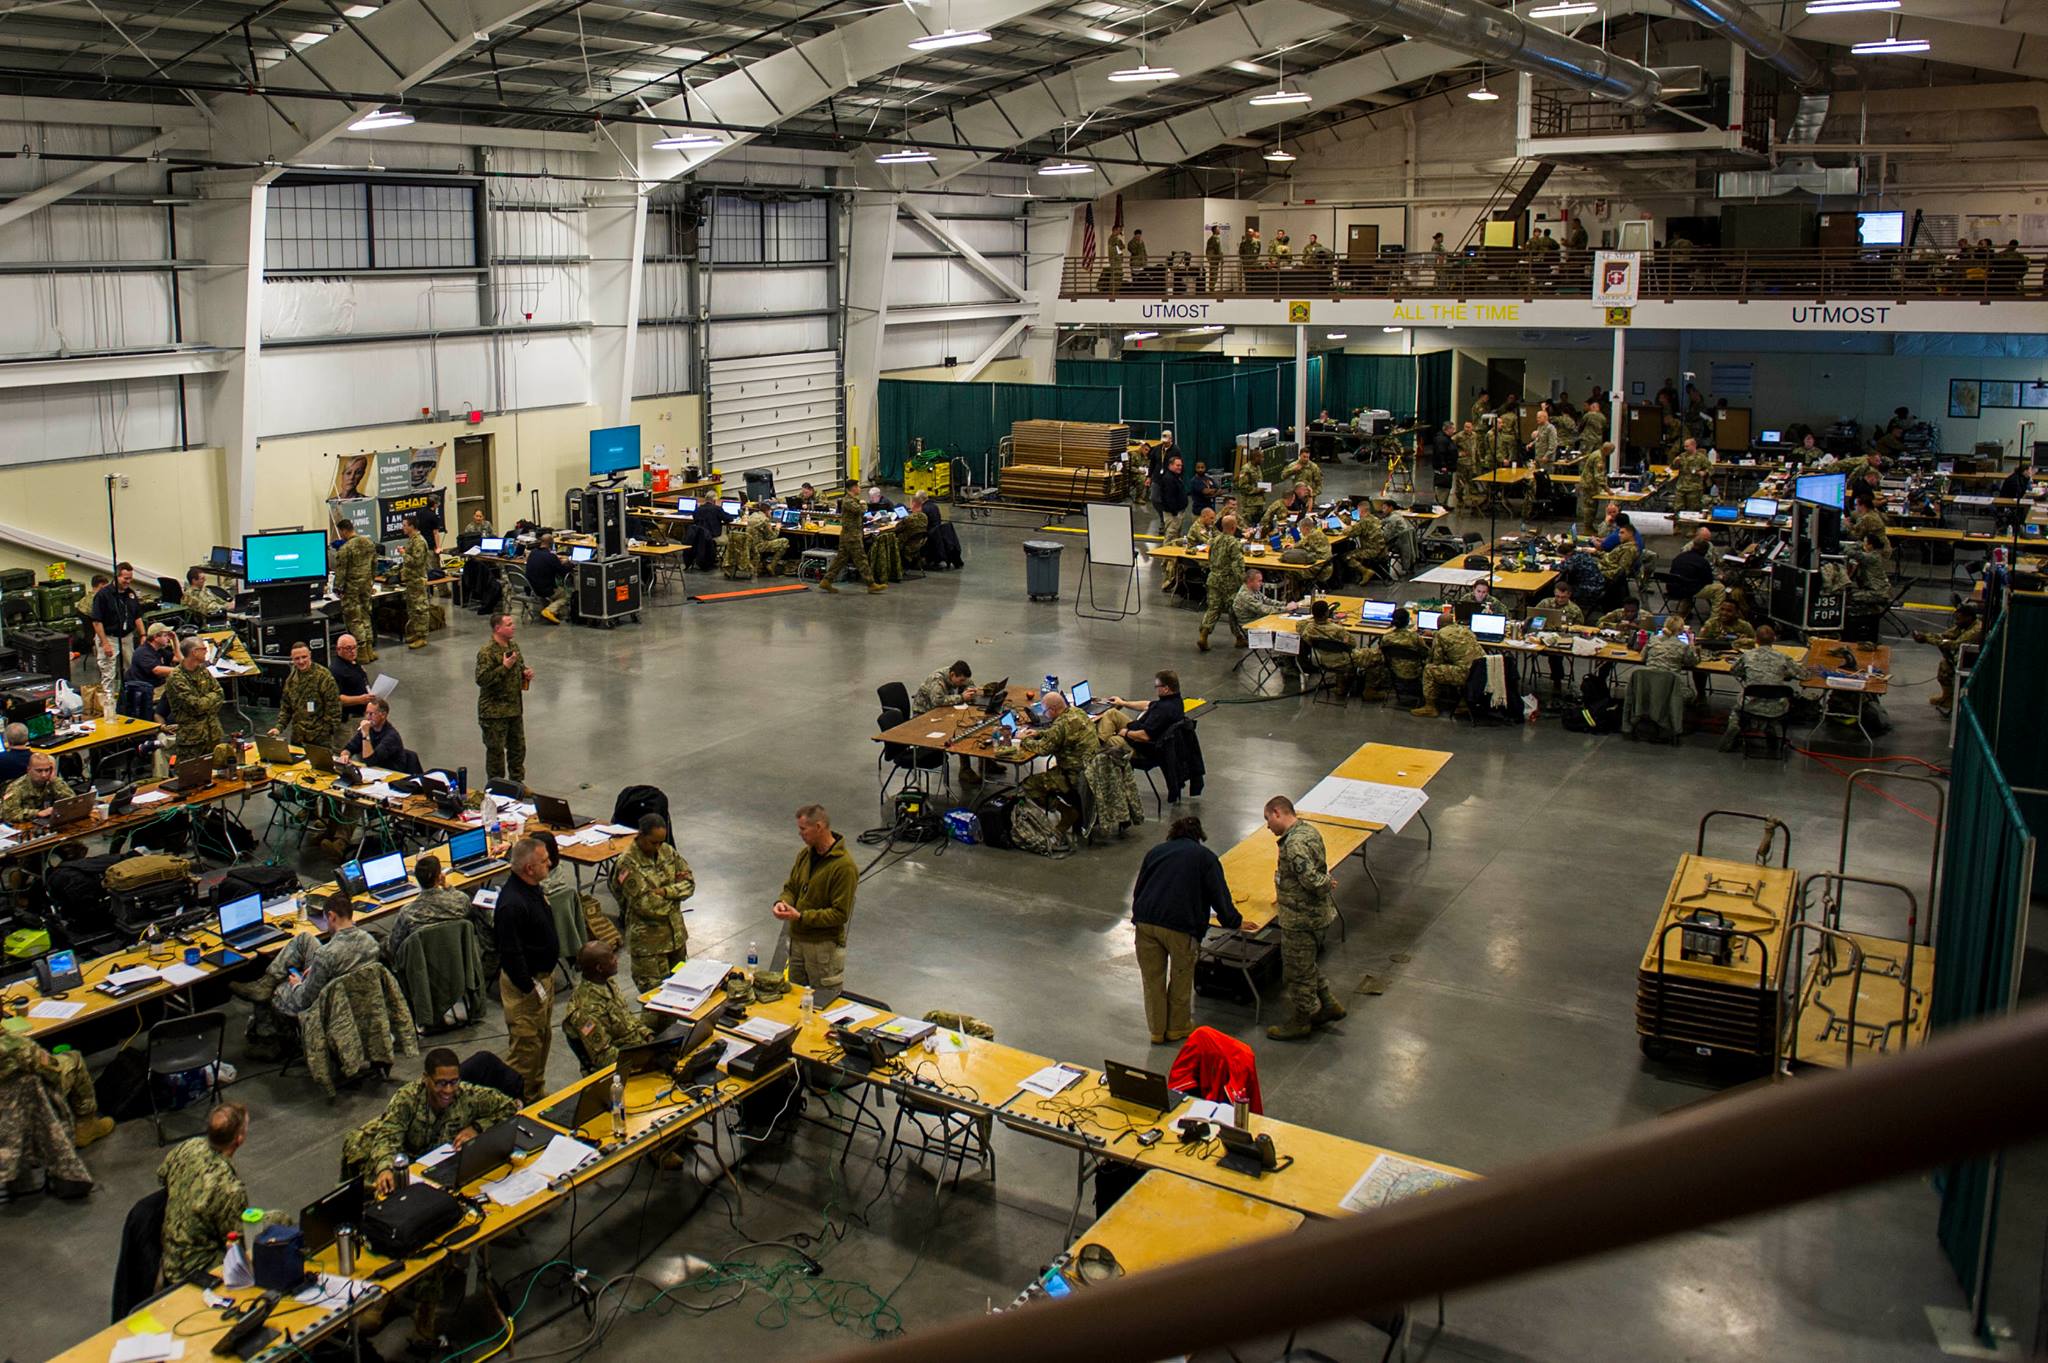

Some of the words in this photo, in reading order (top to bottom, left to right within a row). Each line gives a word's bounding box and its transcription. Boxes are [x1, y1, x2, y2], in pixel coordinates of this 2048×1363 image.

[1142, 304, 1210, 318] UTMOST
[1393, 305, 1425, 320] ALL
[1430, 305, 1468, 320] THE
[1476, 305, 1520, 321] TIME
[1792, 307, 1891, 324] UTMOST
[394, 497, 428, 511] SHAR
